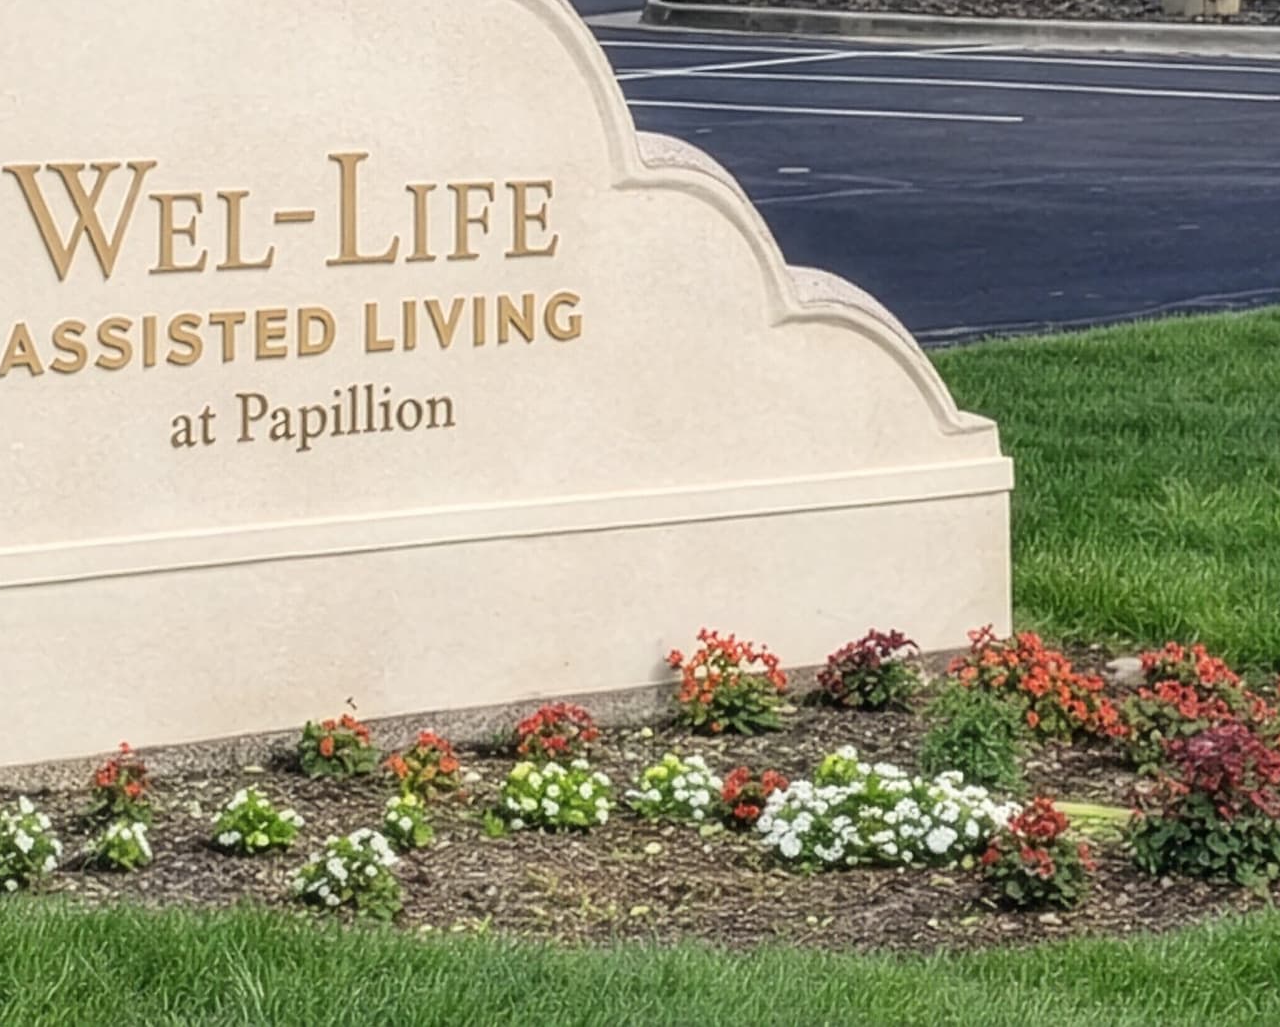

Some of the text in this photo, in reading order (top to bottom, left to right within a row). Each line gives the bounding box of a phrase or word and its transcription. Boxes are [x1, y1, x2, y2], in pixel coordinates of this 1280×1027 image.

[364, 291, 584, 355] LIVING
[169, 384, 457, 454] at Papillion
